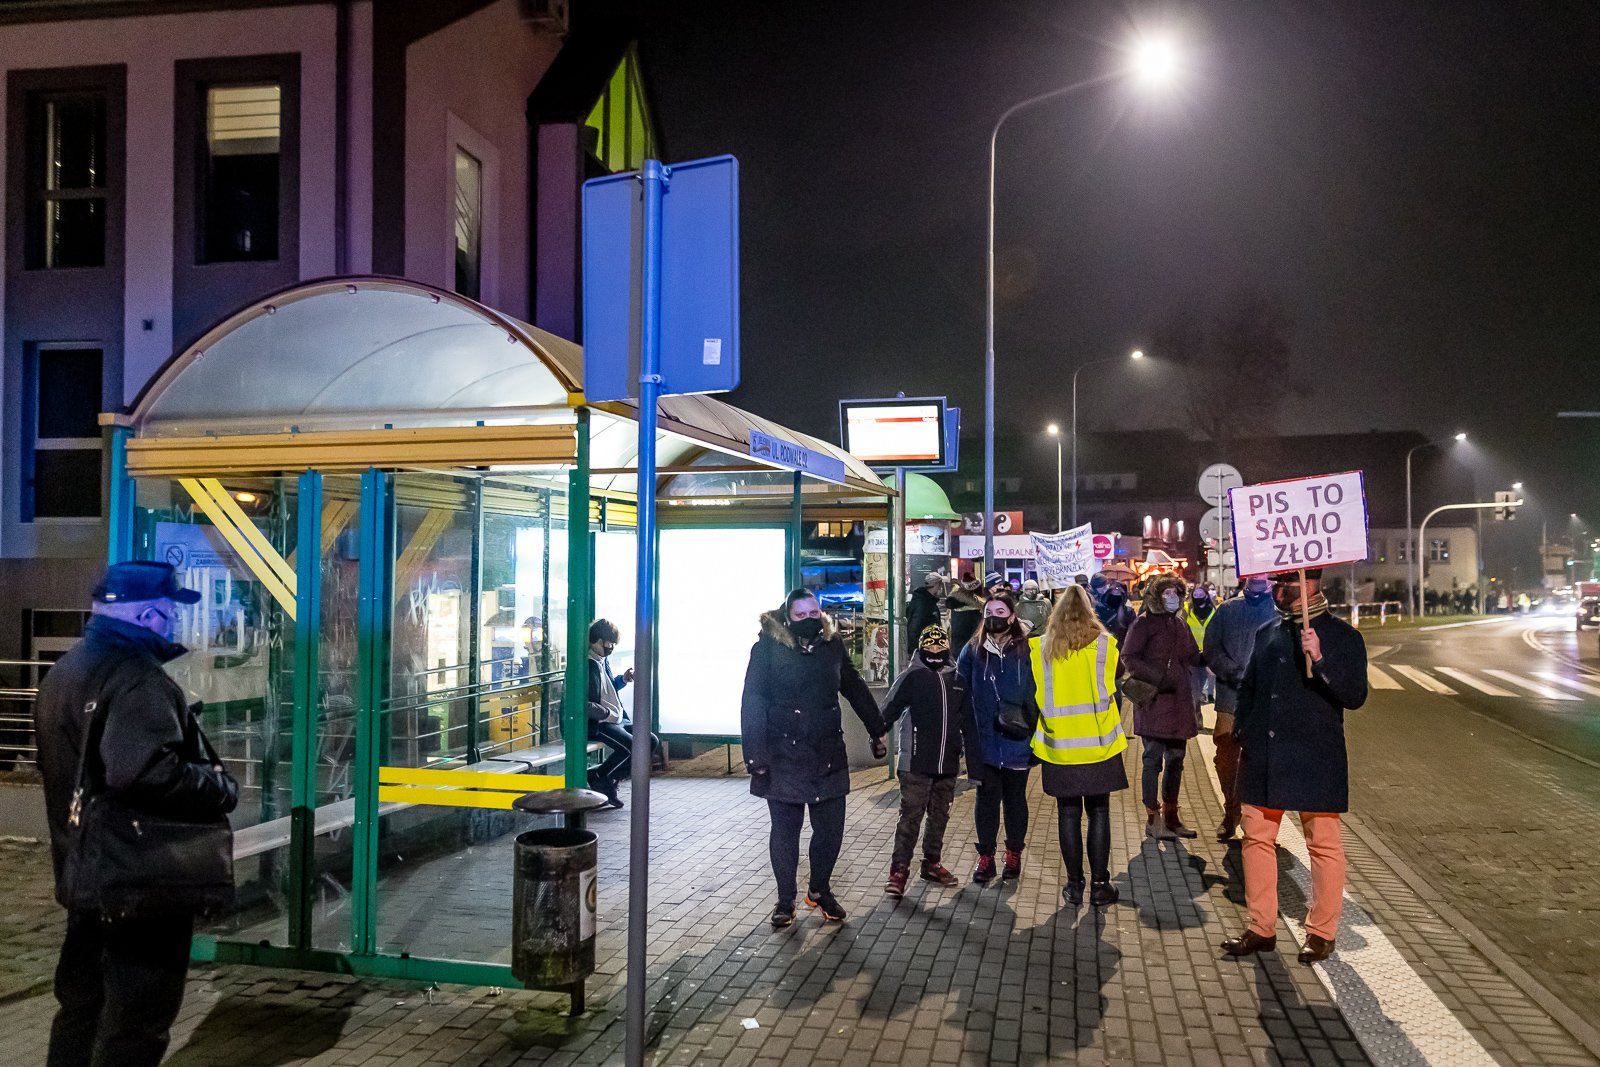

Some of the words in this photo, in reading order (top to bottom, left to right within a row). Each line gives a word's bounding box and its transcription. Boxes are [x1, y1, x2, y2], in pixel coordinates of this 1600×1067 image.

[1249, 491, 1289, 516] PIS
[1307, 483, 1343, 507] TO
[1256, 512, 1341, 541] SAMO
[967, 548, 984, 556] LOD
[993, 548, 1034, 556] ATURALNE
[1273, 537, 1332, 566] ZŁO!
